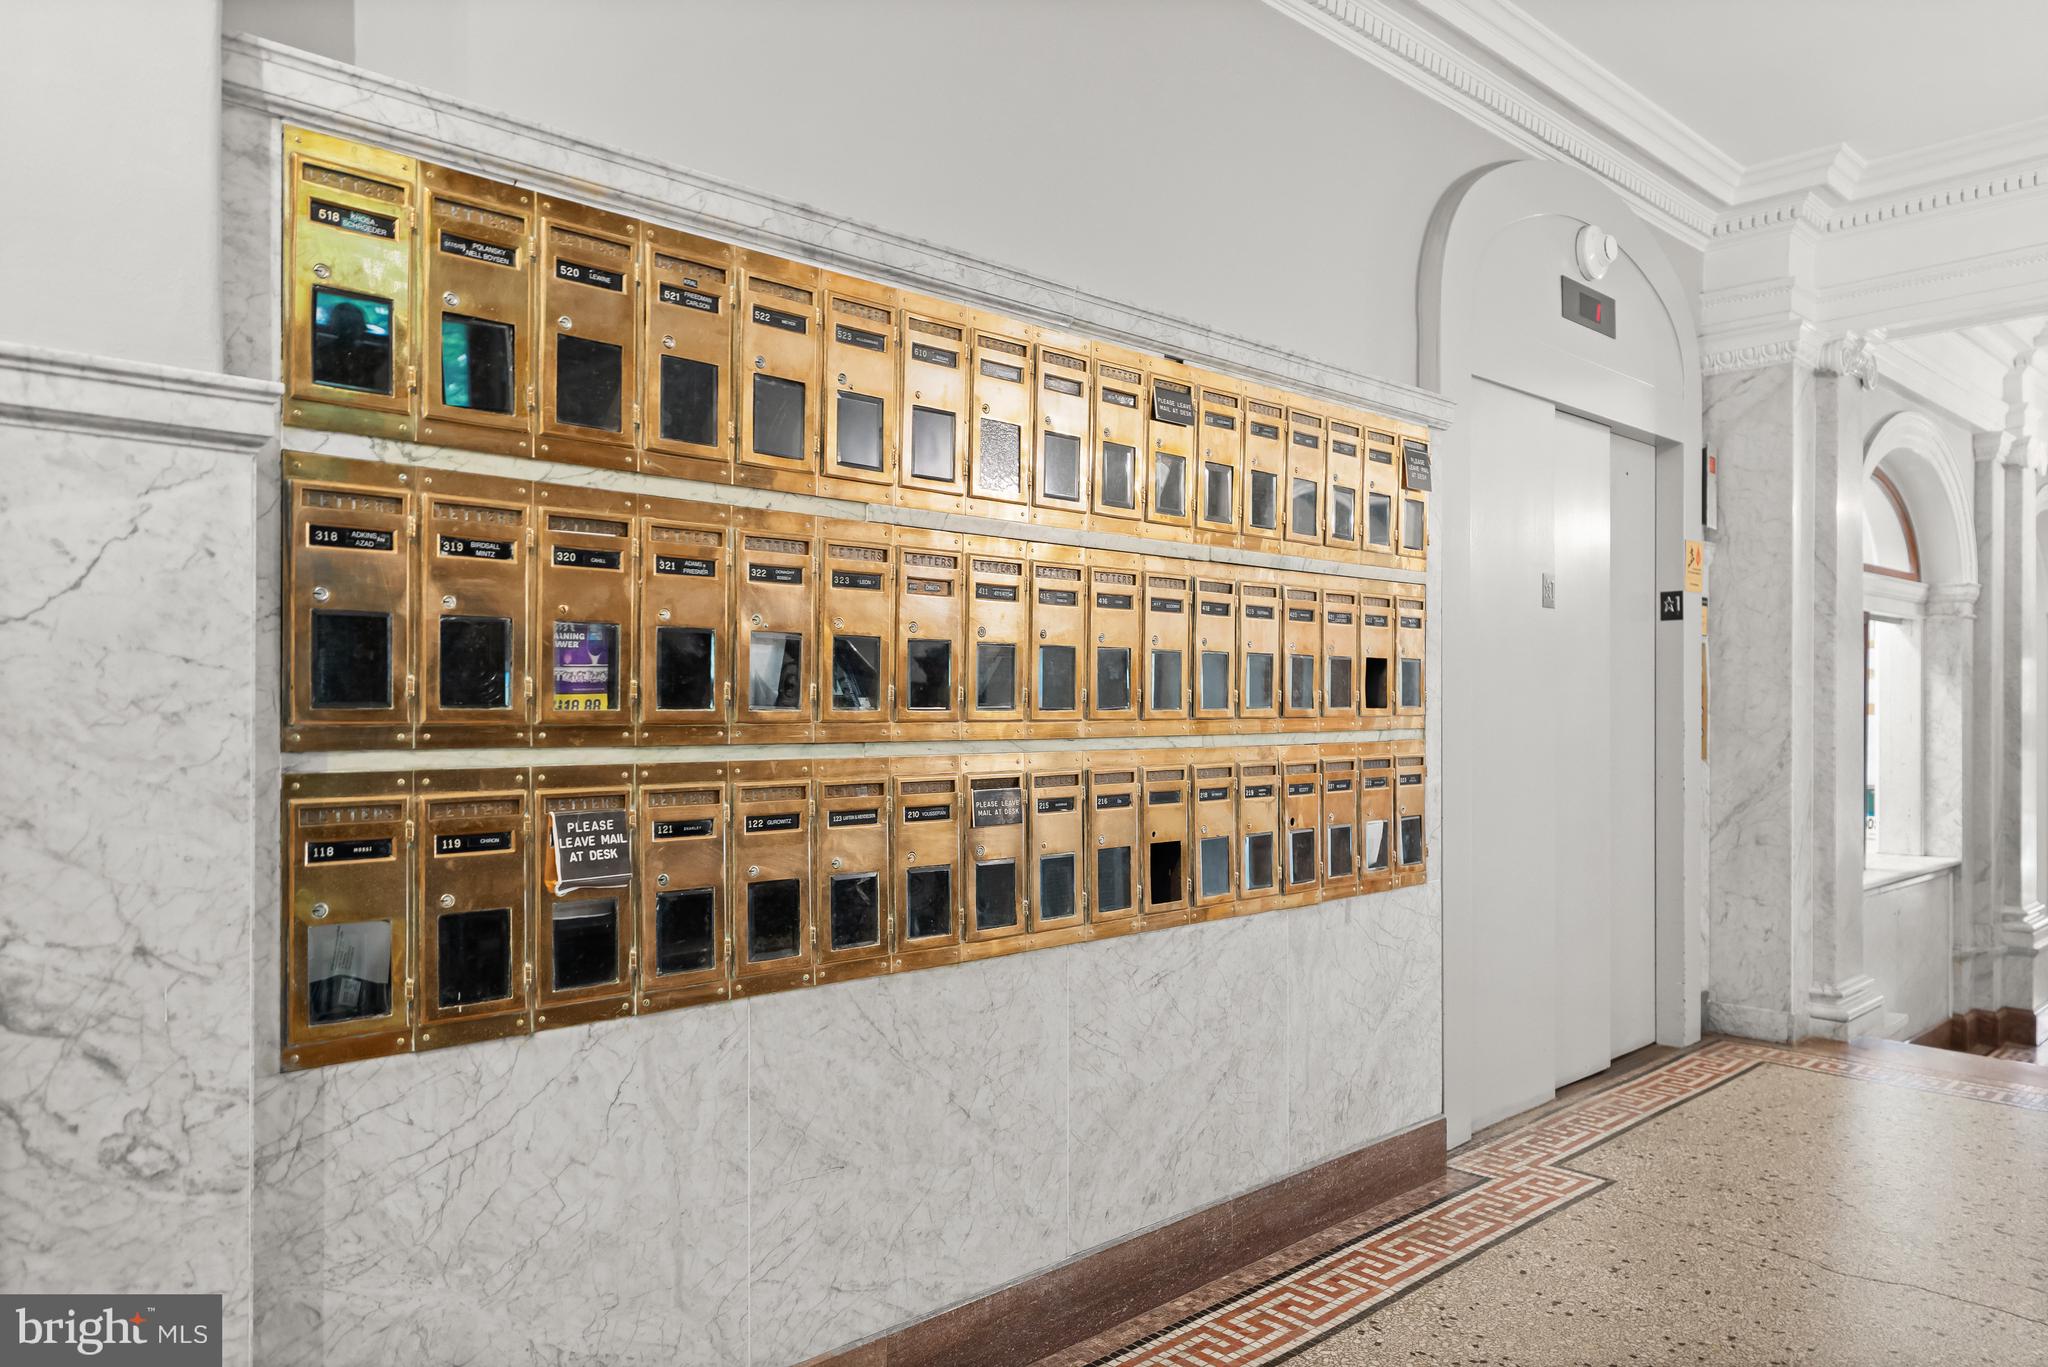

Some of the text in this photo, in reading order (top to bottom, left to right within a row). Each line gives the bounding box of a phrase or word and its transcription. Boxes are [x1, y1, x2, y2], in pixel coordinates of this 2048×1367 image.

[318, 208, 340, 223] 518
[342, 218, 387, 236] SCHROEDER
[472, 242, 506, 256] POLANSKY
[560, 266, 580, 278] 520
[664, 290, 680, 301] 521
[685, 300, 711, 310] CARLSON
[754, 310, 771, 322] 522
[1595, 303, 1601, 322] 1
[837, 330, 852, 341] 523
[914, 348, 927, 358] 610
[1157, 397, 1192, 411] PLEASE LEAVE
[1159, 405, 1170, 413] MAIL
[1180, 409, 1193, 417] DESK
[1410, 457, 1425, 466] PLEASE
[315, 530, 338, 541] 318
[351, 531, 378, 540] ADKINS
[355, 539, 375, 548] AZAD
[443, 541, 464, 552] 319
[470, 542, 500, 551] BIRDSALL
[475, 549, 496, 558] MINTZ
[556, 552, 577, 562] 320
[831, 545, 883, 561] LETTERS
[659, 561, 676, 570] 321
[904, 553, 953, 568] LETTERS
[751, 568, 767, 577] 322
[972, 560, 1018, 575] LETTERS
[833, 576, 850, 585] 323
[1094, 571, 1133, 585] LETTERS
[978, 586, 988, 595] 411
[1039, 591, 1050, 600] 415
[1675, 595, 1681, 612] 1
[975, 799, 1020, 808] PLEASE LEAVE
[1039, 801, 1050, 810] 215
[1097, 797, 1108, 805] 216
[978, 809, 992, 817] MAIL
[1004, 807, 1020, 815] DESK
[748, 819, 763, 828] 122
[767, 818, 792, 826] GUROWITZ
[833, 815, 842, 823] 123
[567, 819, 614, 833] PLEASE
[657, 824, 673, 834] 121
[442, 839, 461, 849] 119
[558, 833, 628, 849] LEAVE MAIL
[313, 847, 334, 857] 118
[570, 848, 618, 862] AT DESK
